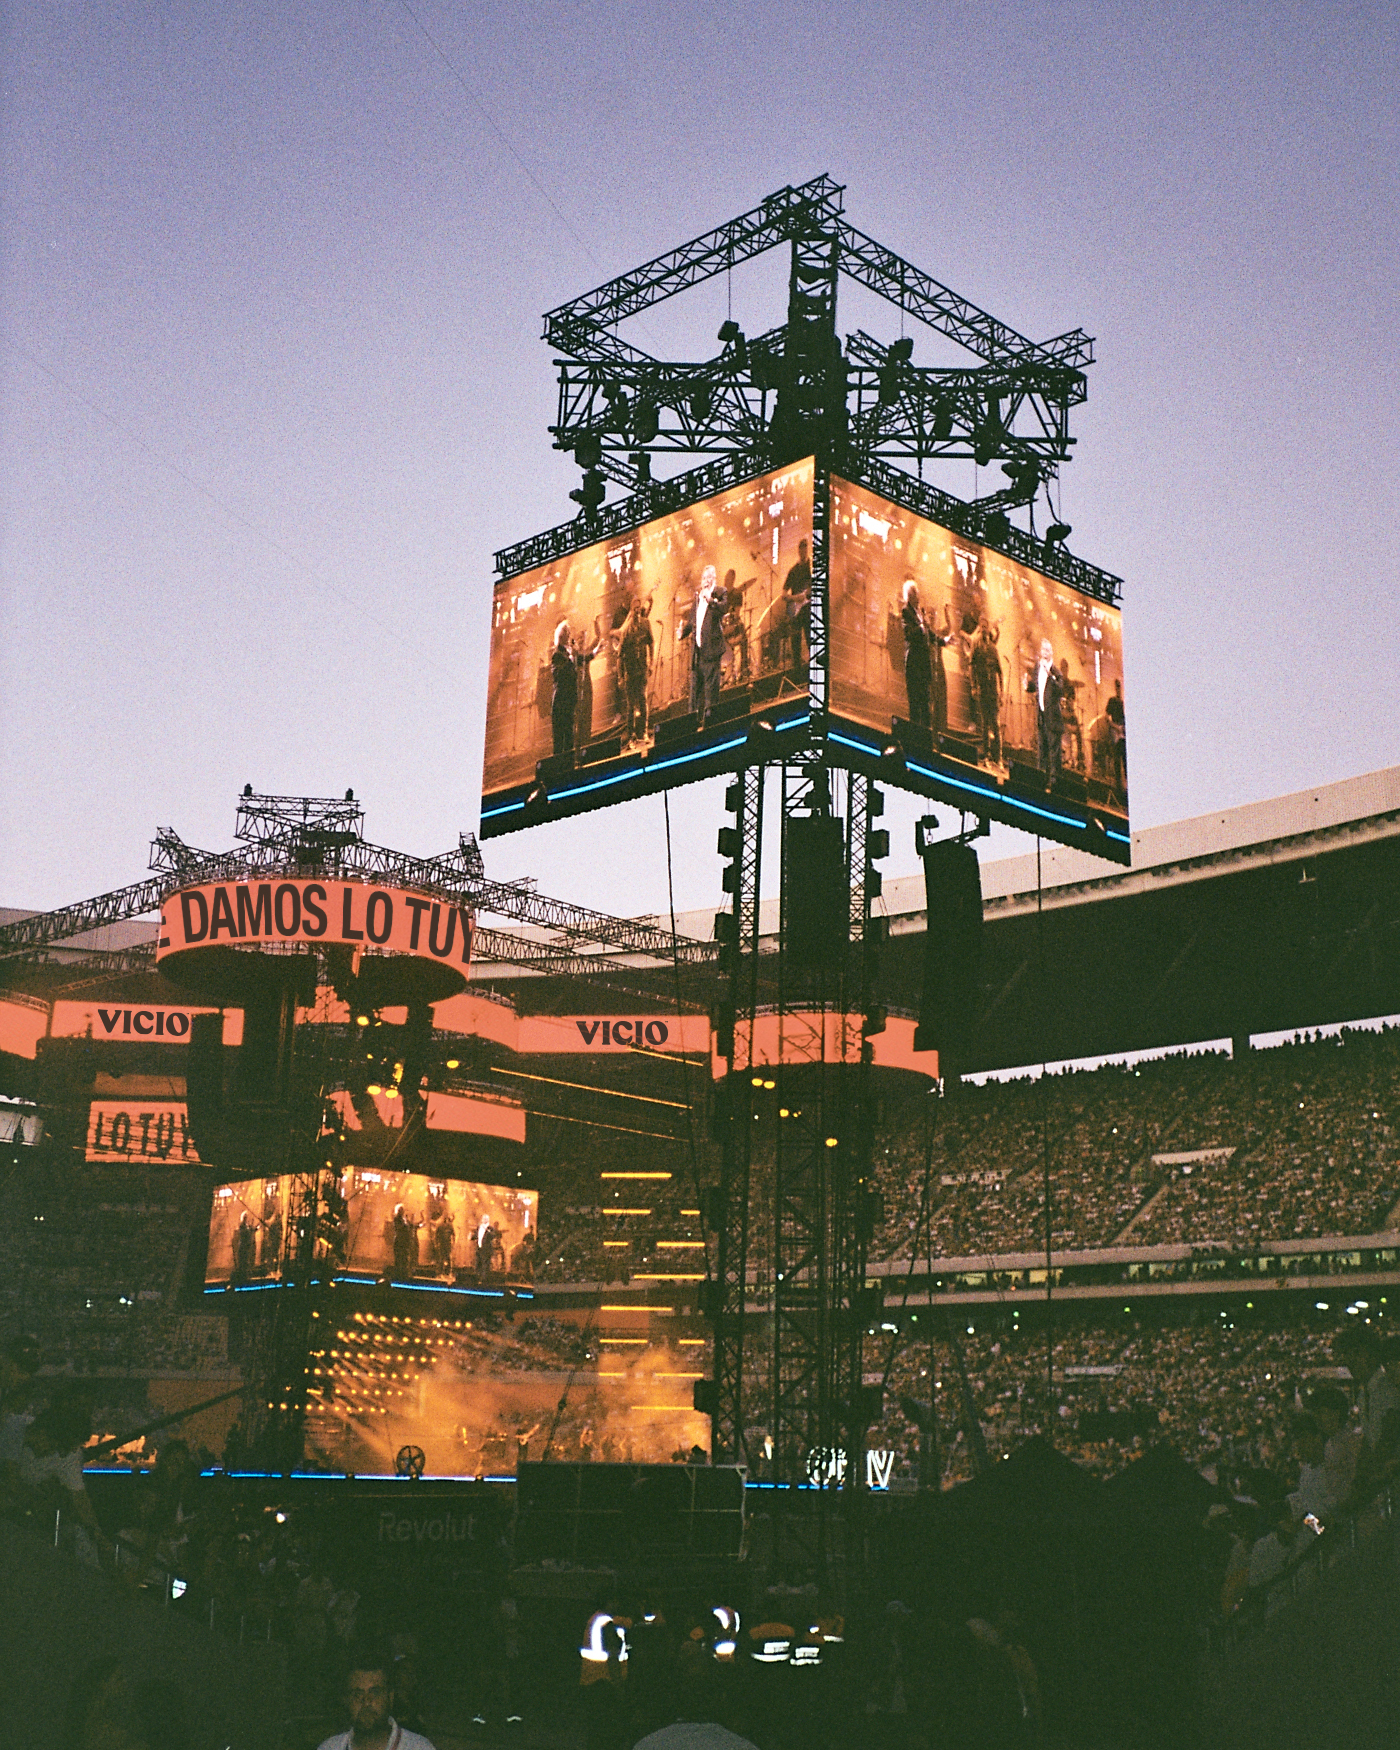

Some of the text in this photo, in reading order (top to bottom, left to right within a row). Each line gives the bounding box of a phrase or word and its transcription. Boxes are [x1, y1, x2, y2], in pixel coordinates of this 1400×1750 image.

[180, 883, 328, 943] DAMOS
[341, 887, 393, 944] LO
[98, 1009, 190, 1036] VICIO
[576, 1020, 669, 1045] VICIO
[379, 1512, 476, 1541] Revolut
